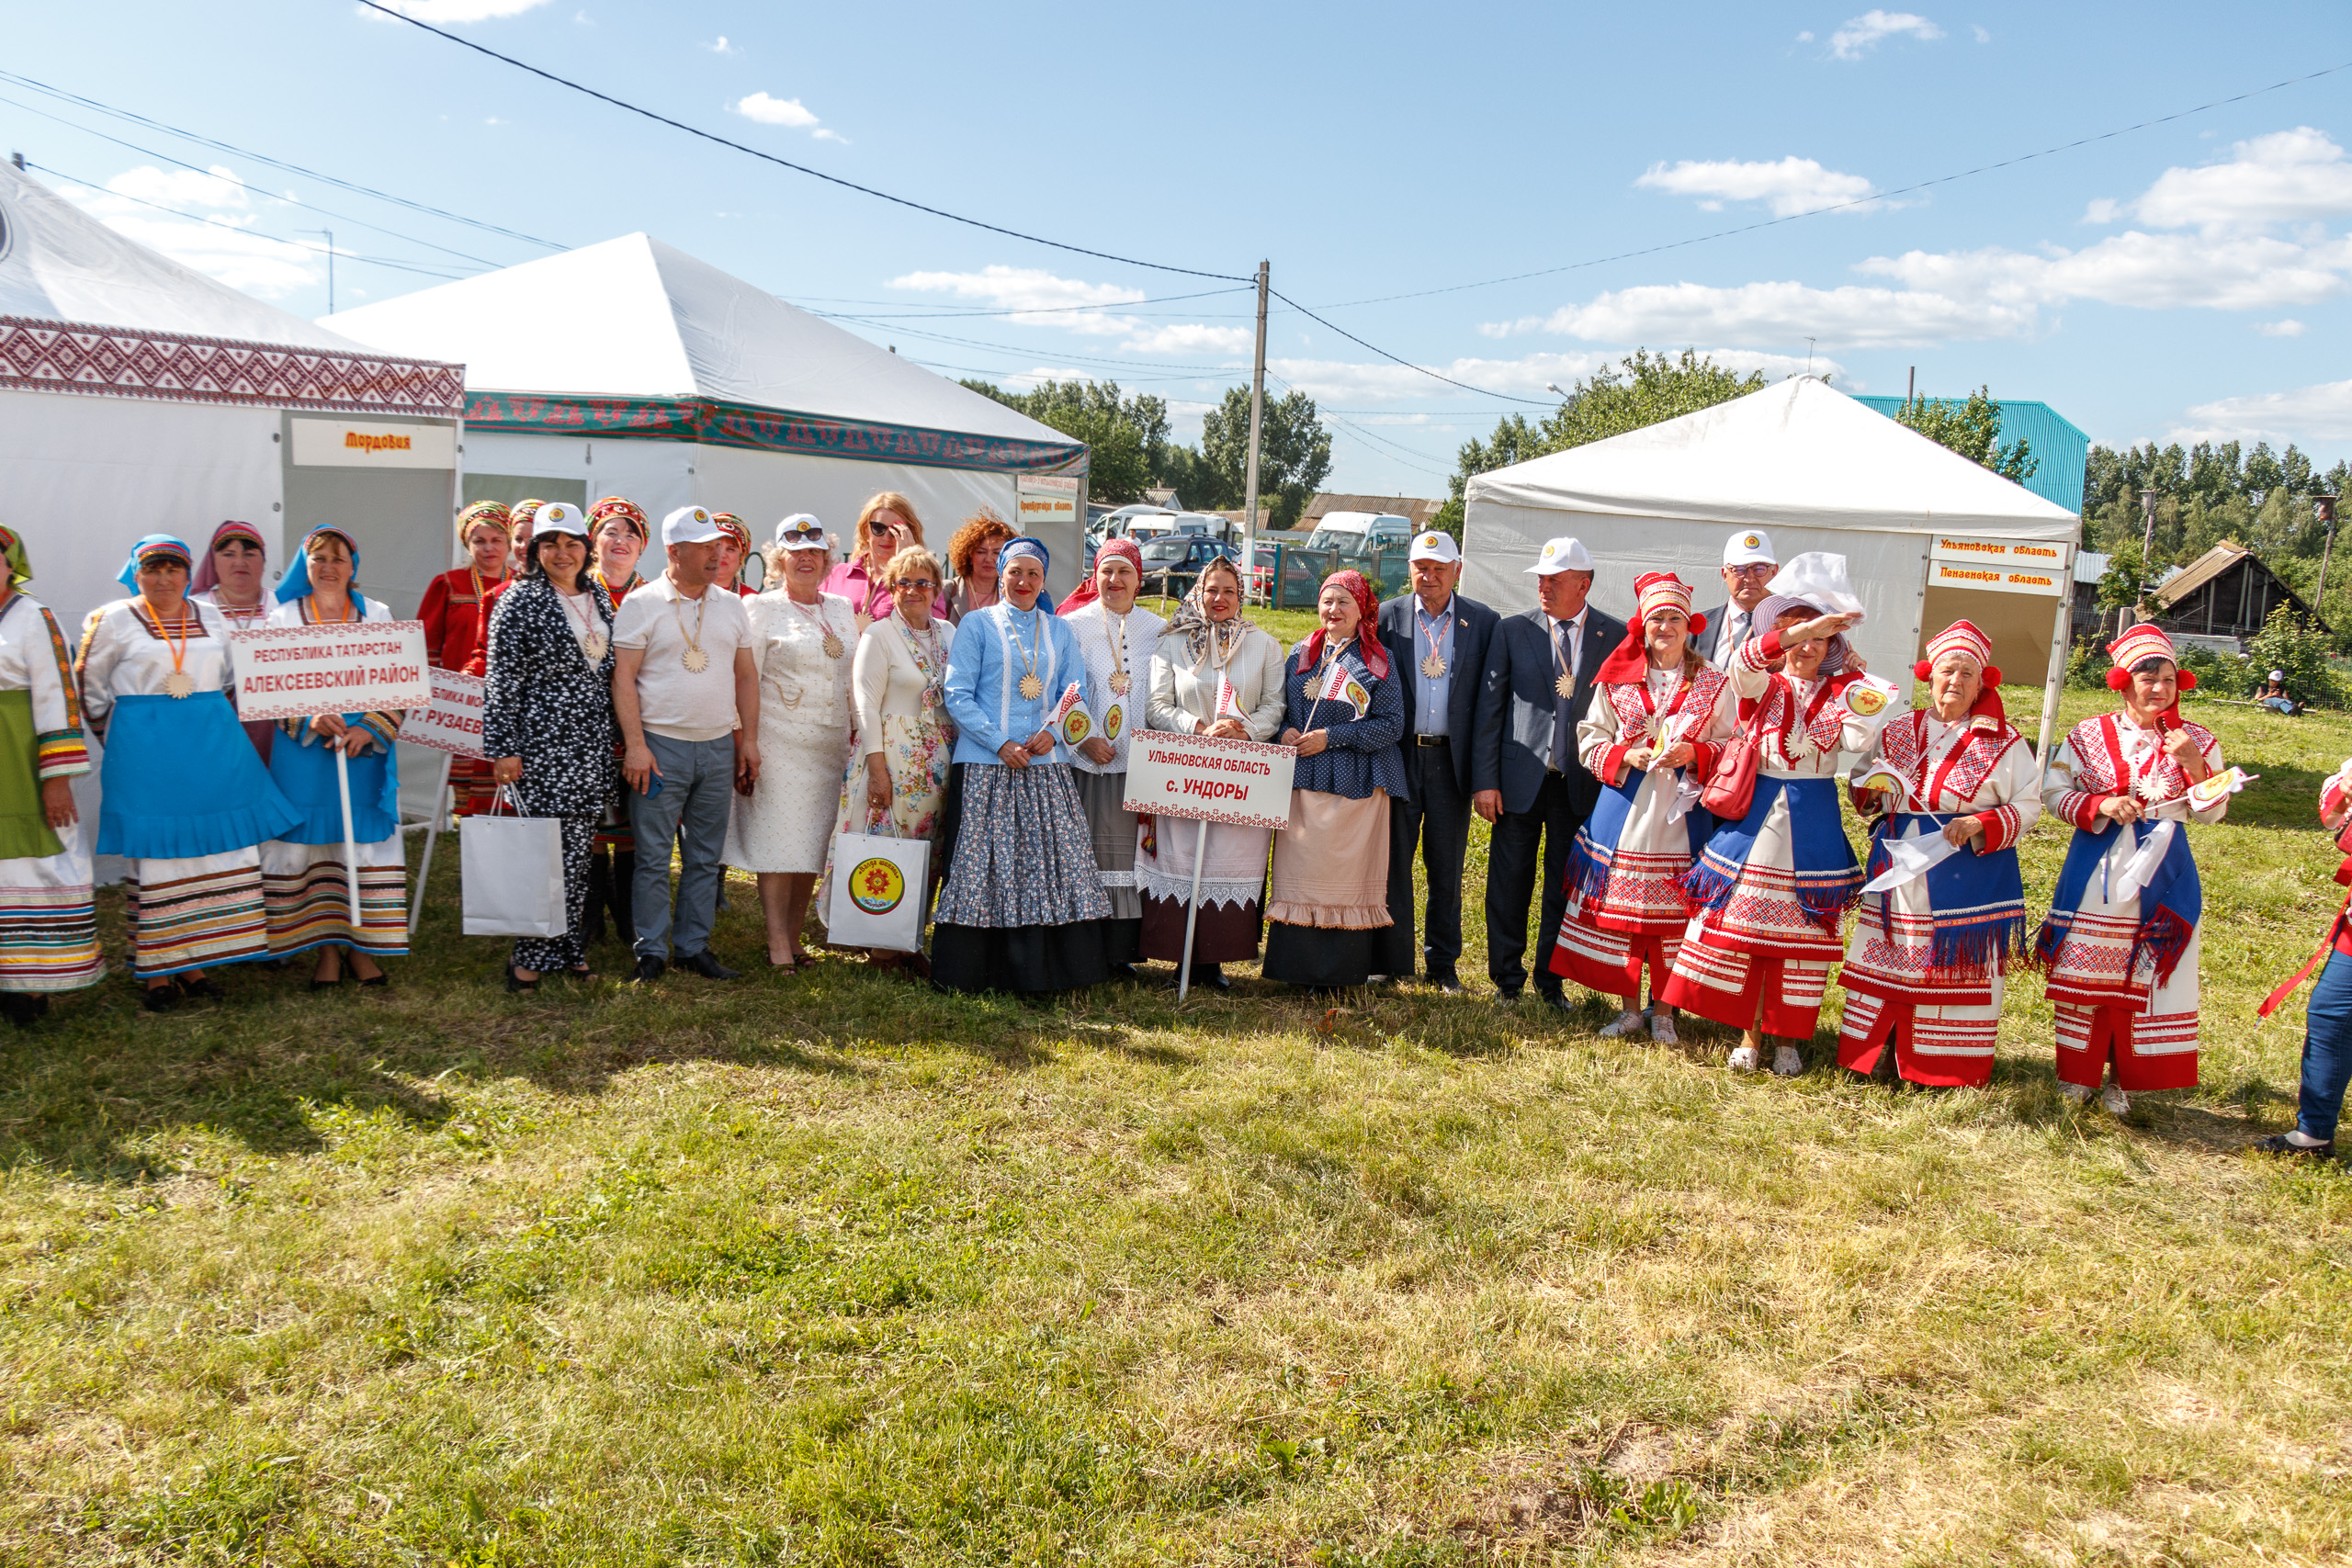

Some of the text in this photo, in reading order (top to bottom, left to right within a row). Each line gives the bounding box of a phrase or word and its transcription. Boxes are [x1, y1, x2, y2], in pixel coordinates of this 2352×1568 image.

[345, 431, 411, 455] Мордовия
[1940, 538, 2058, 558] Ульяновская область
[1939, 567, 2052, 586] Пензенская область
[254, 641, 402, 663] РЕСПУБЛИКА ТАТАРСТАН
[243, 662, 420, 694] АЛЕКСЕЕВСКИЙ РАЙОН
[432, 686, 464, 704] БЛИКА
[411, 709, 484, 736] г. РУЗАЕВ
[1148, 750, 1271, 776] УЛЬЯНОВСКАЯ ОБЛАСТЬ
[1166, 778, 1250, 801] с. УНДОРЫ
